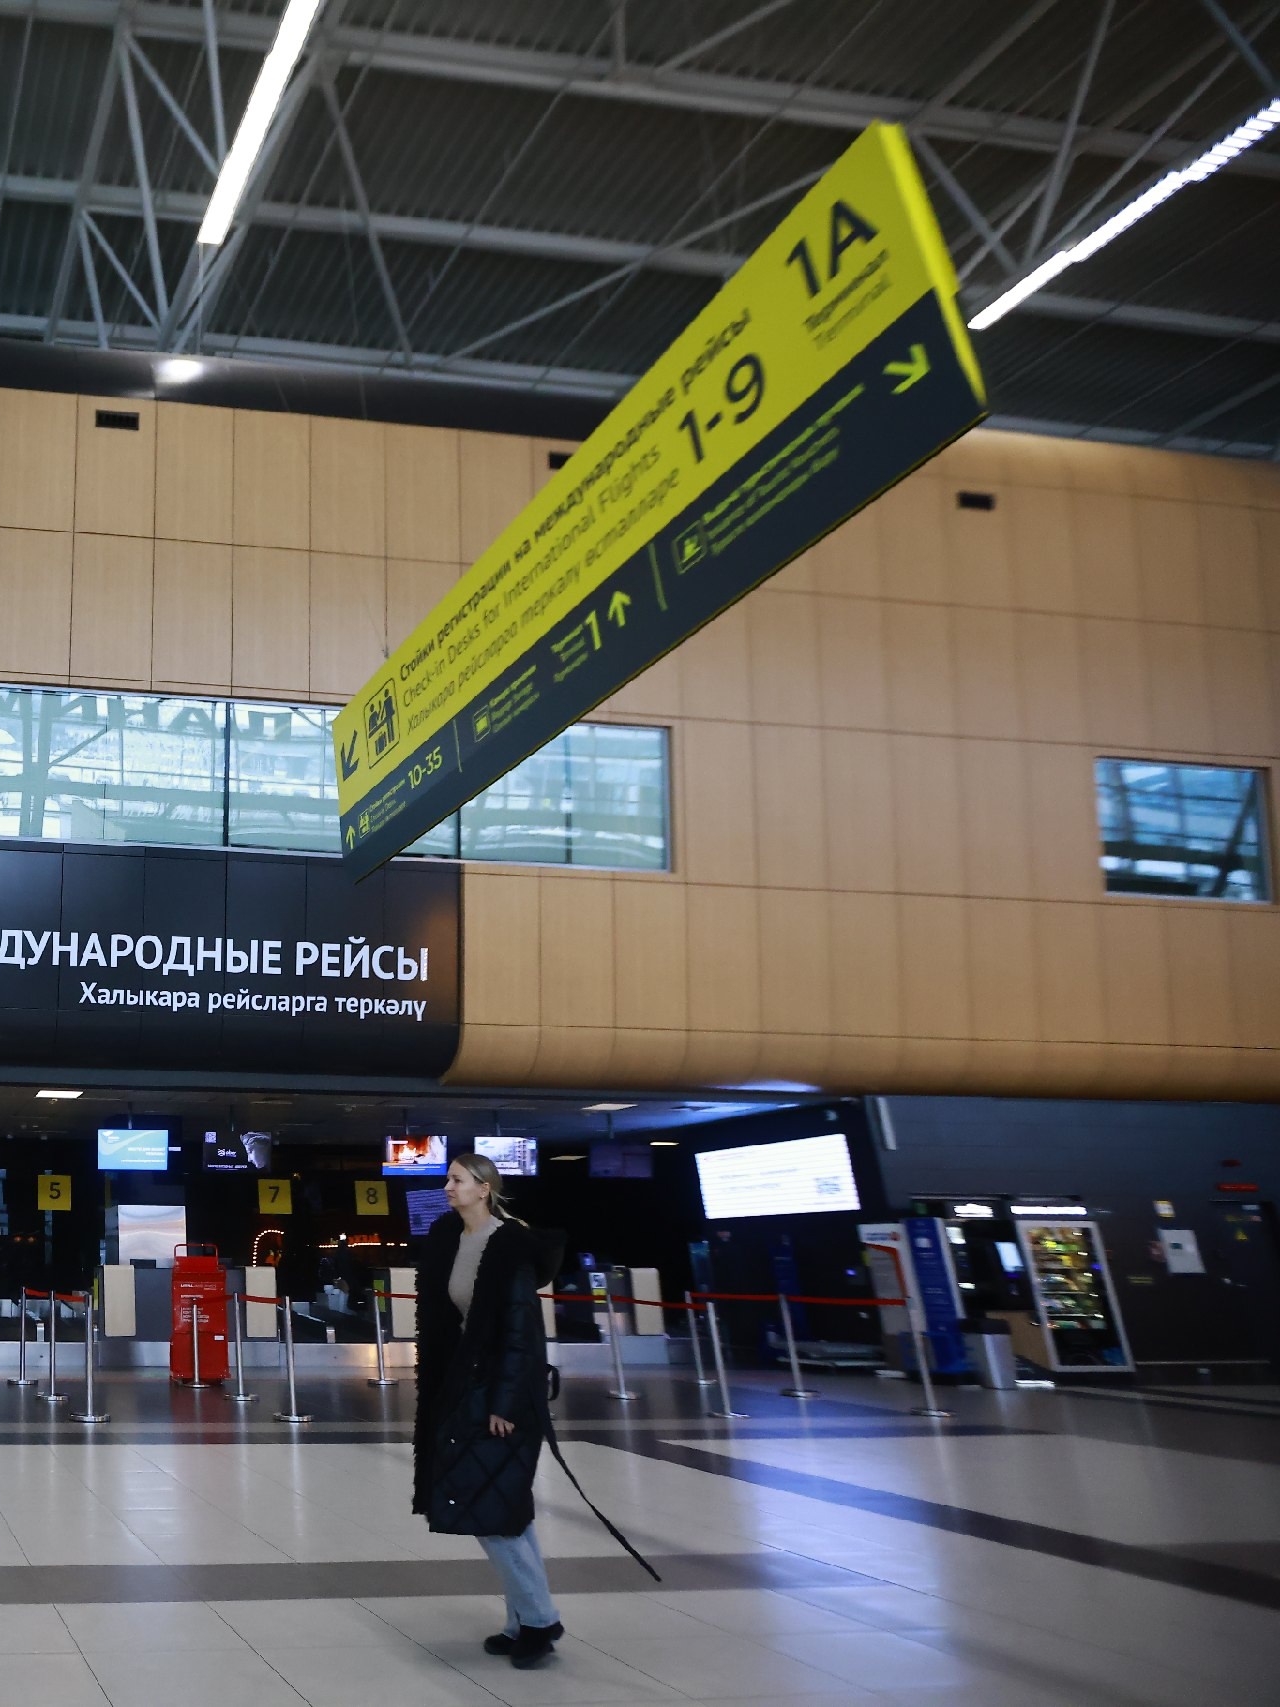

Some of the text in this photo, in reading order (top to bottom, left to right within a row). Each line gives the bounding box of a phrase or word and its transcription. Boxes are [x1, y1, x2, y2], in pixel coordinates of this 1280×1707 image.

[678, 352, 766, 463] 1-9
[400, 639, 434, 681] Стойки
[437, 560, 510, 647] регистрации
[513, 539, 531, 562] на
[534, 387, 675, 541] международные
[680, 308, 751, 395] рейсы
[403, 659, 444, 706] Check-in
[447, 624, 480, 663] Desks
[483, 603, 499, 627] for
[504, 506, 594, 606] International
[598, 445, 659, 511] Flights
[585, 610, 602, 650] 1
[408, 746, 442, 789] 10-35
[295, 937, 429, 982] РЕЙСЫ
[79, 981, 427, 1021] Халыкара рейсларга теркәлү
[49, 1181, 61, 1200] 5
[269, 1186, 280, 1204] 7
[366, 1187, 378, 1205] 8
